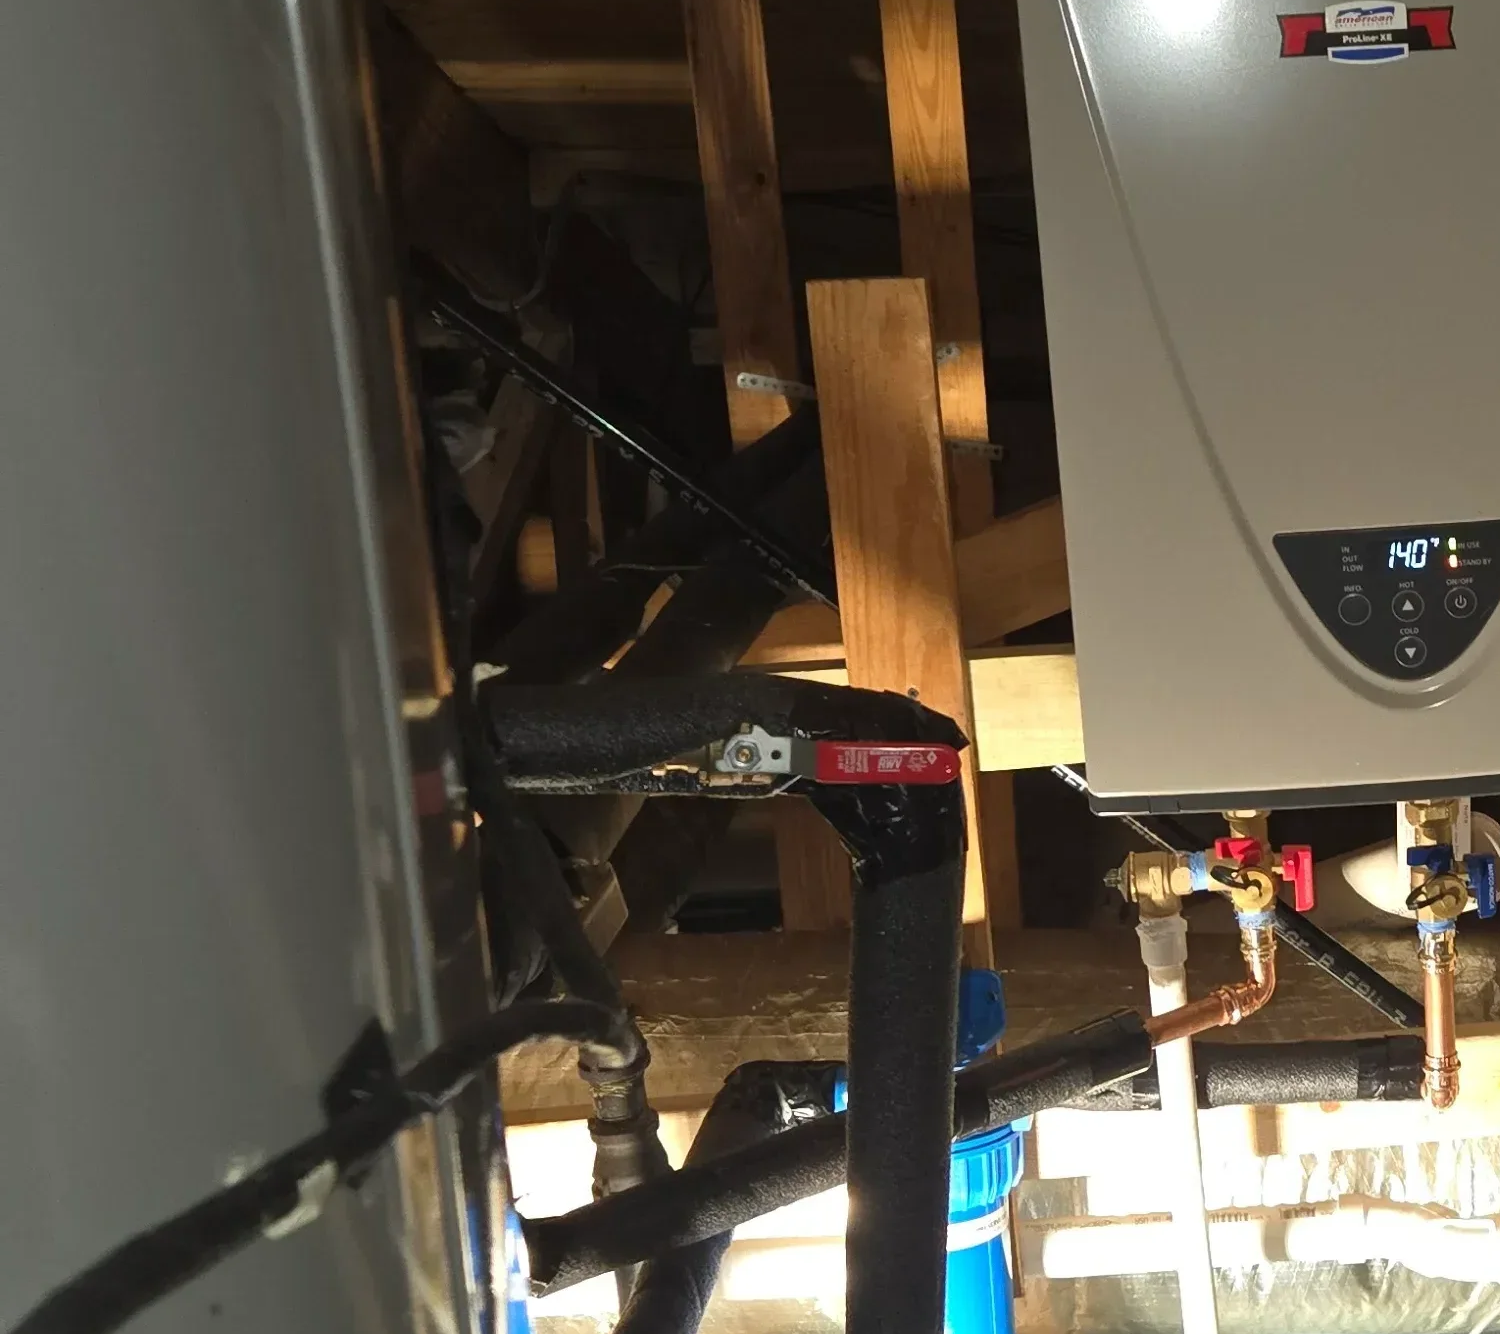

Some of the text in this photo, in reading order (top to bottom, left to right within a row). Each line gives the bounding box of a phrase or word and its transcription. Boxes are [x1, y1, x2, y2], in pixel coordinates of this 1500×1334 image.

[1341, 555, 1358, 563] OUT
[1342, 564, 1364, 572] FLOW
[1399, 581, 1415, 589] HOT
[1400, 627, 1420, 635] COLD
